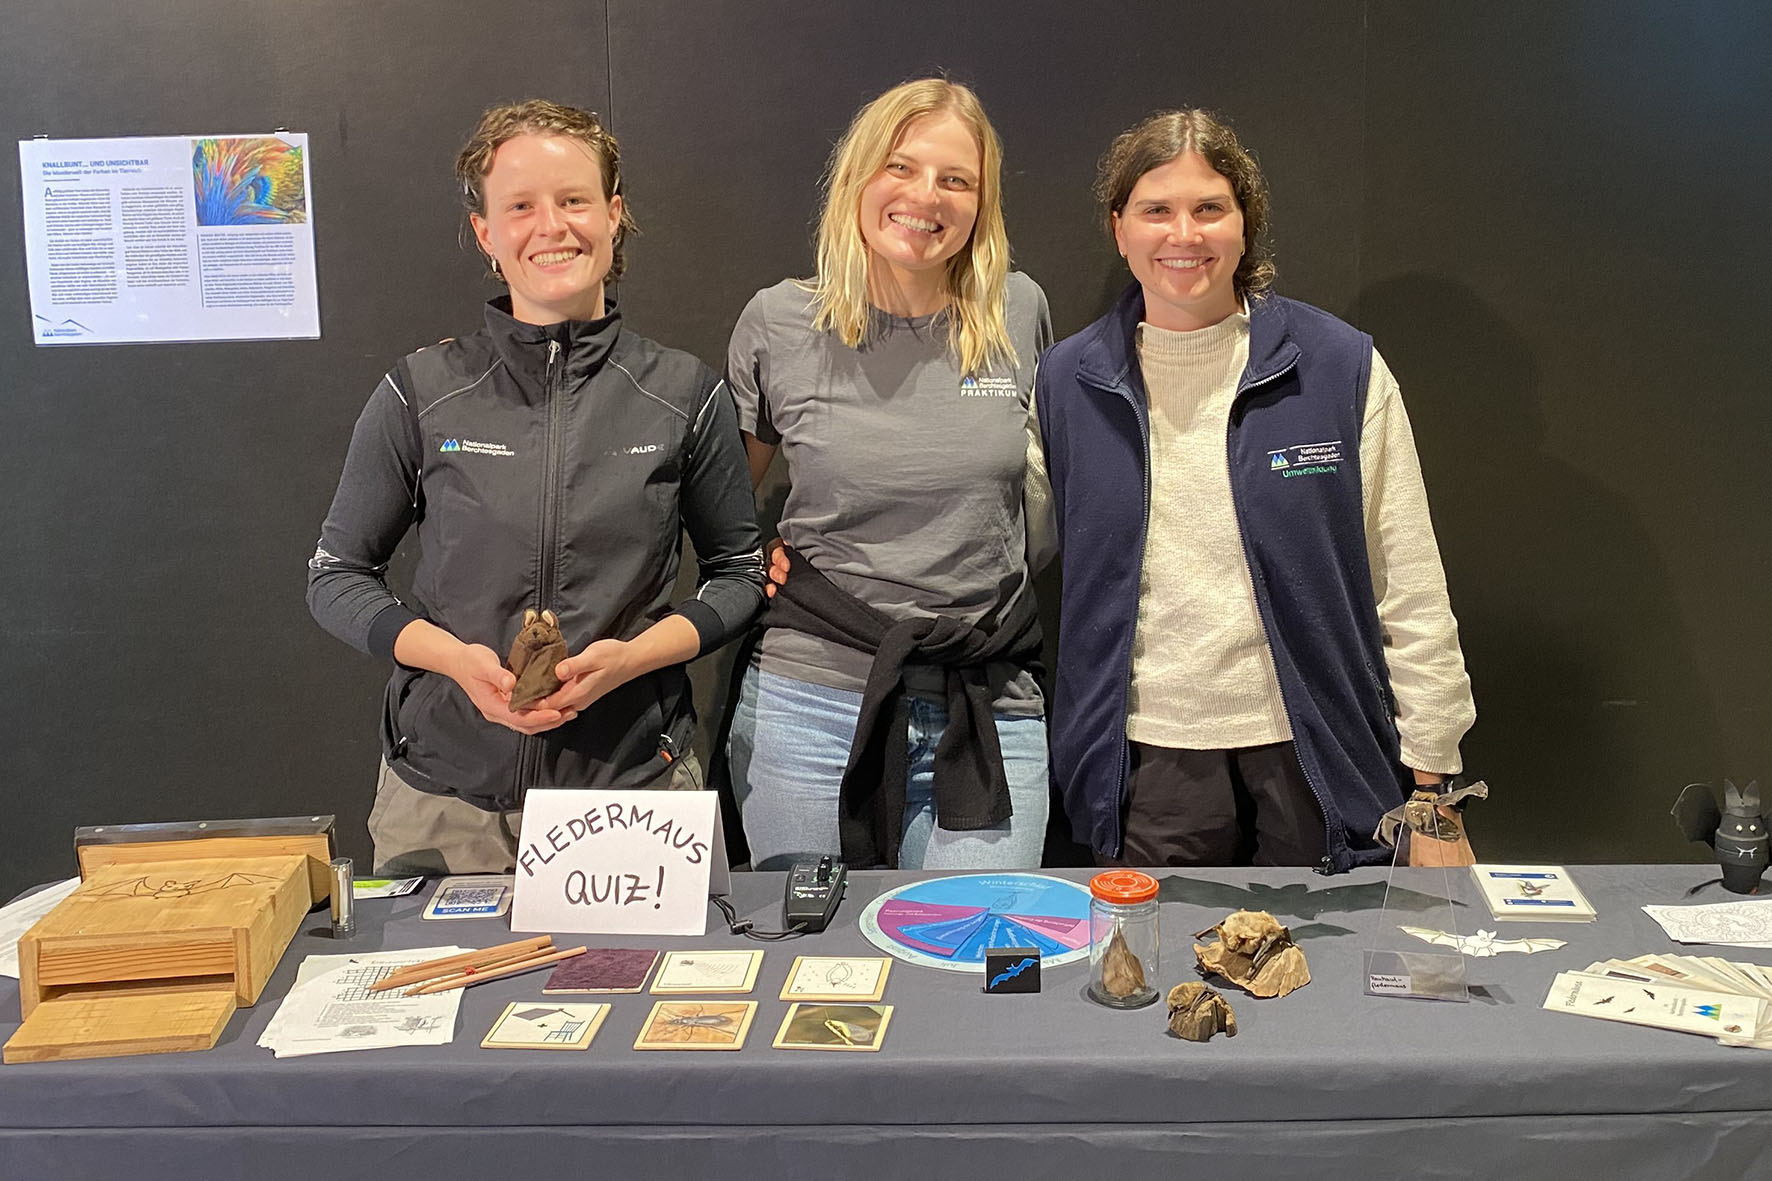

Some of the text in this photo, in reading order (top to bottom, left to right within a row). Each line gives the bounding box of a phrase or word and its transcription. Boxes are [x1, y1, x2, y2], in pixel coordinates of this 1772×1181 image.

[106, 159, 149, 167] UNSICHTBAR
[461, 445, 515, 456] Berchtesgaden
[462, 440, 507, 451] Nationalpark
[623, 443, 665, 455] VAUDE
[1300, 445, 1337, 455] Nationalpark
[519, 803, 709, 877] FLEDERMAUS
[564, 865, 665, 910] QUIZ!
